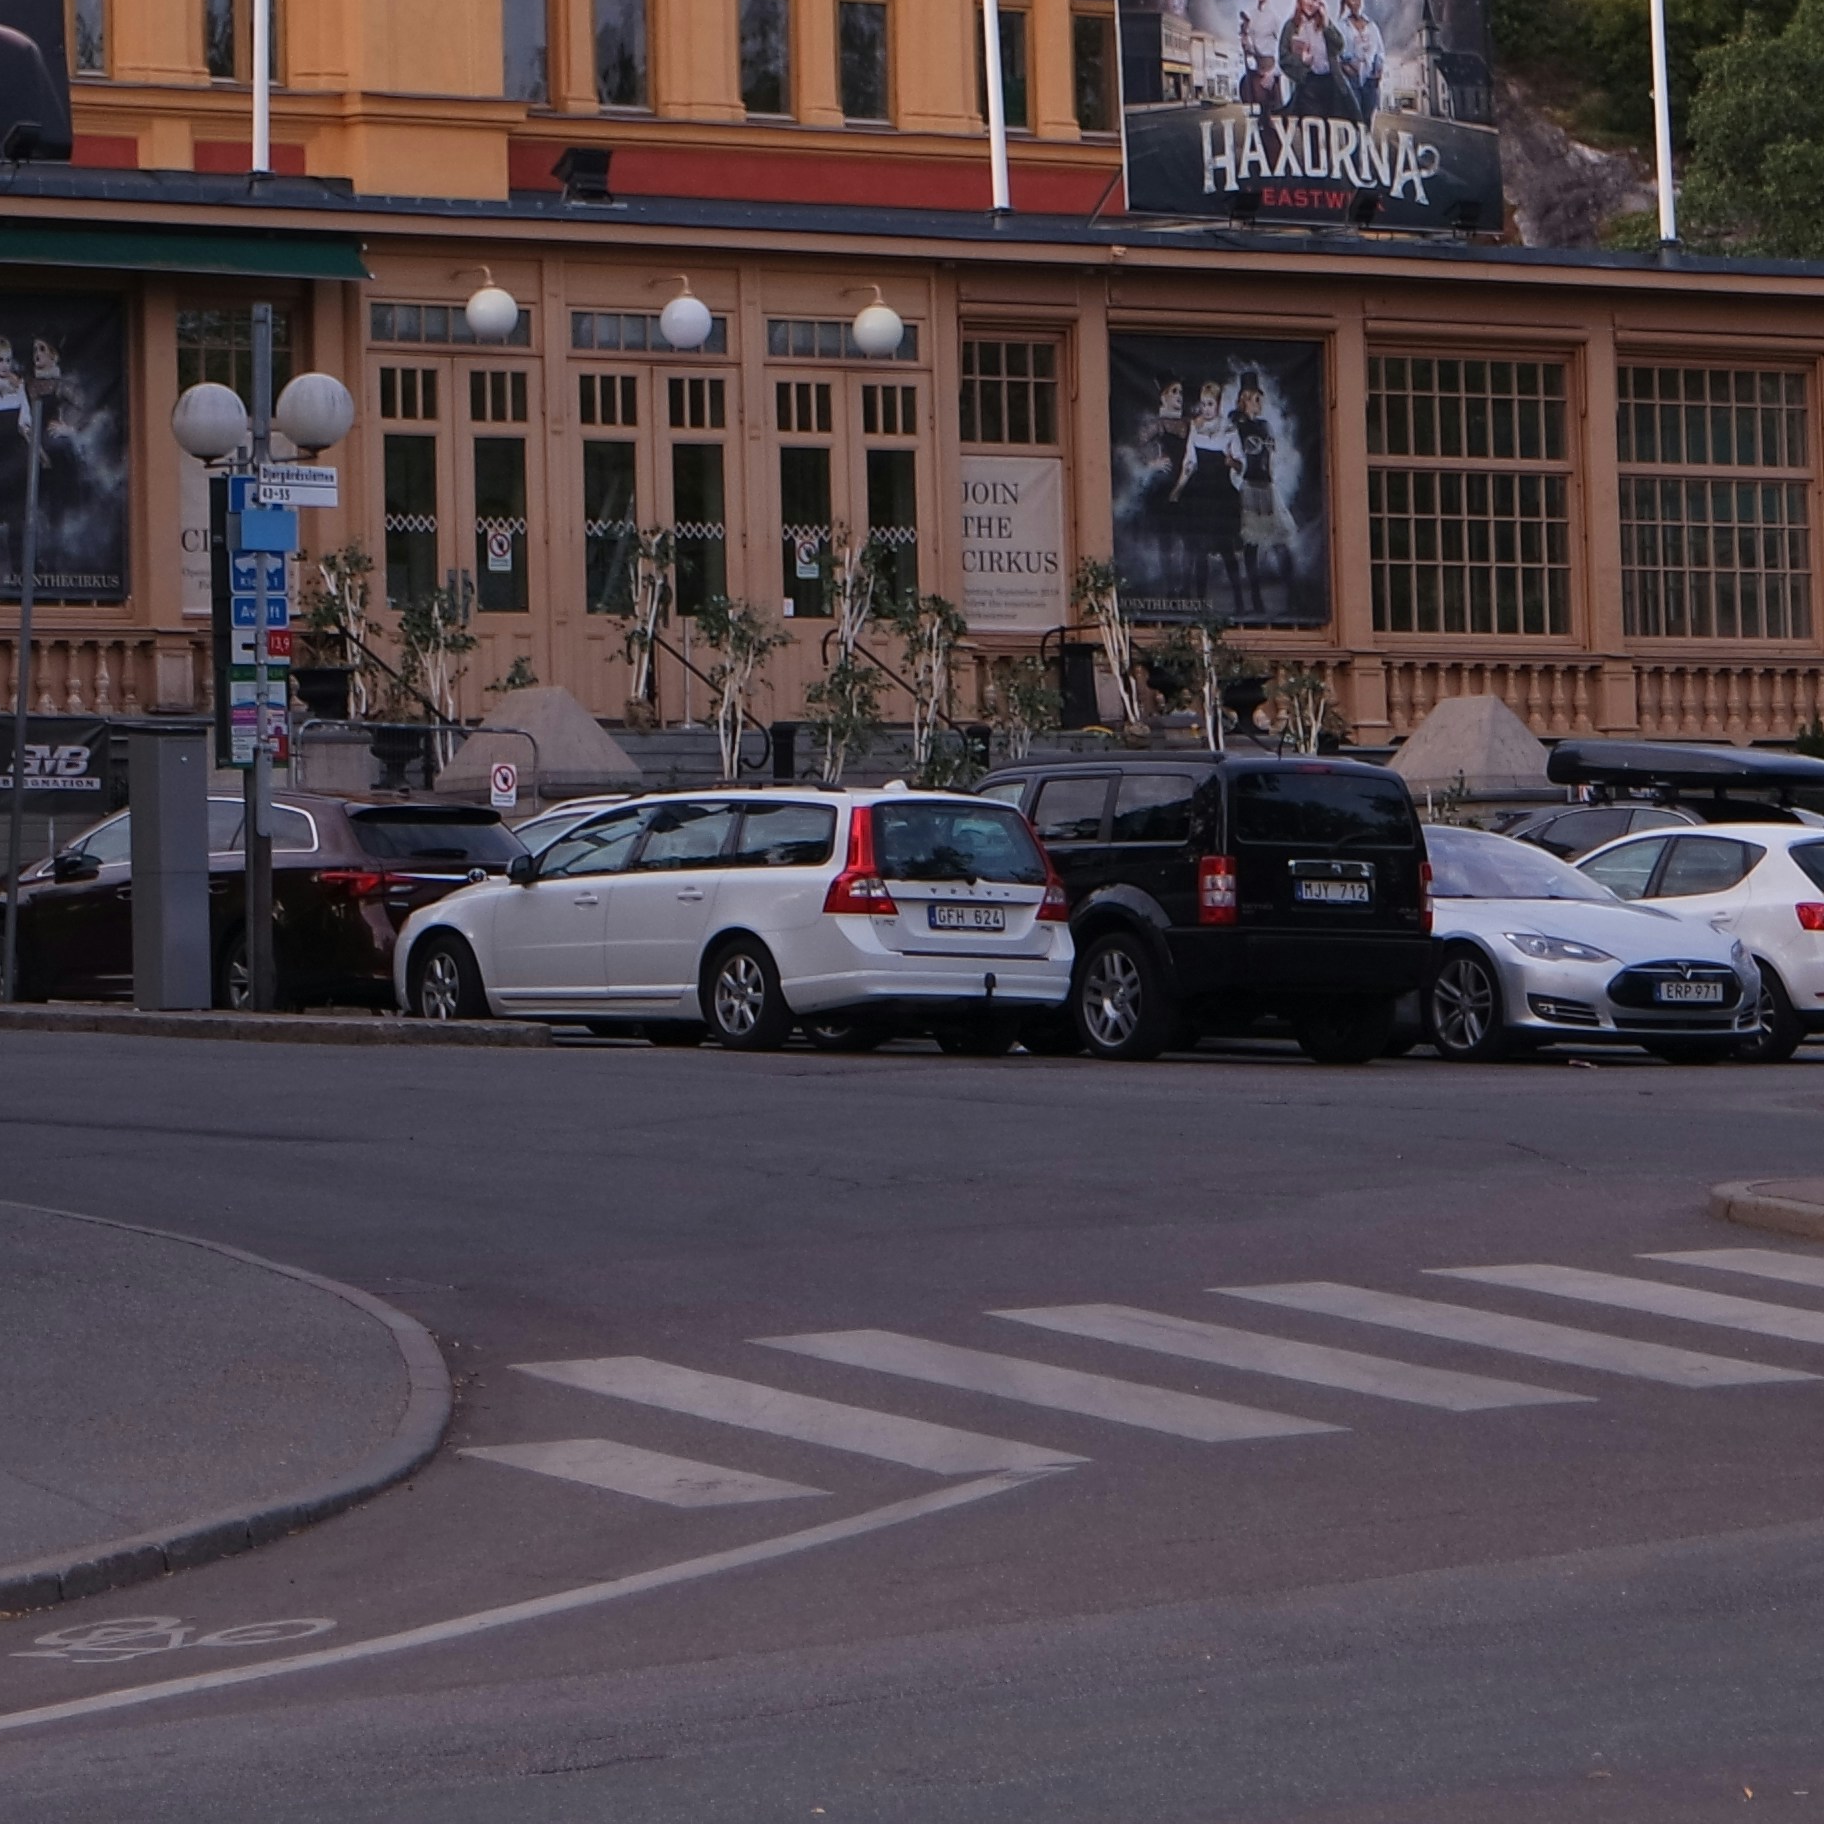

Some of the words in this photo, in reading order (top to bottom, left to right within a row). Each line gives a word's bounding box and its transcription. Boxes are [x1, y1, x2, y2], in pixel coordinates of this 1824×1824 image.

[1199, 103, 1440, 206] HÄXORNA
[962, 481, 1020, 505] JOIN
[961, 515, 1013, 539] THE
[961, 550, 1059, 575] CIRKUS
[241, 604, 281, 619] Avft
[1304, 882, 1329, 899] MJY
[1340, 884, 1366, 900] 712
[938, 908, 966, 924] GFH
[975, 909, 1001, 925] 624
[1666, 983, 1692, 999] ERP
[1695, 984, 1718, 999] 971
